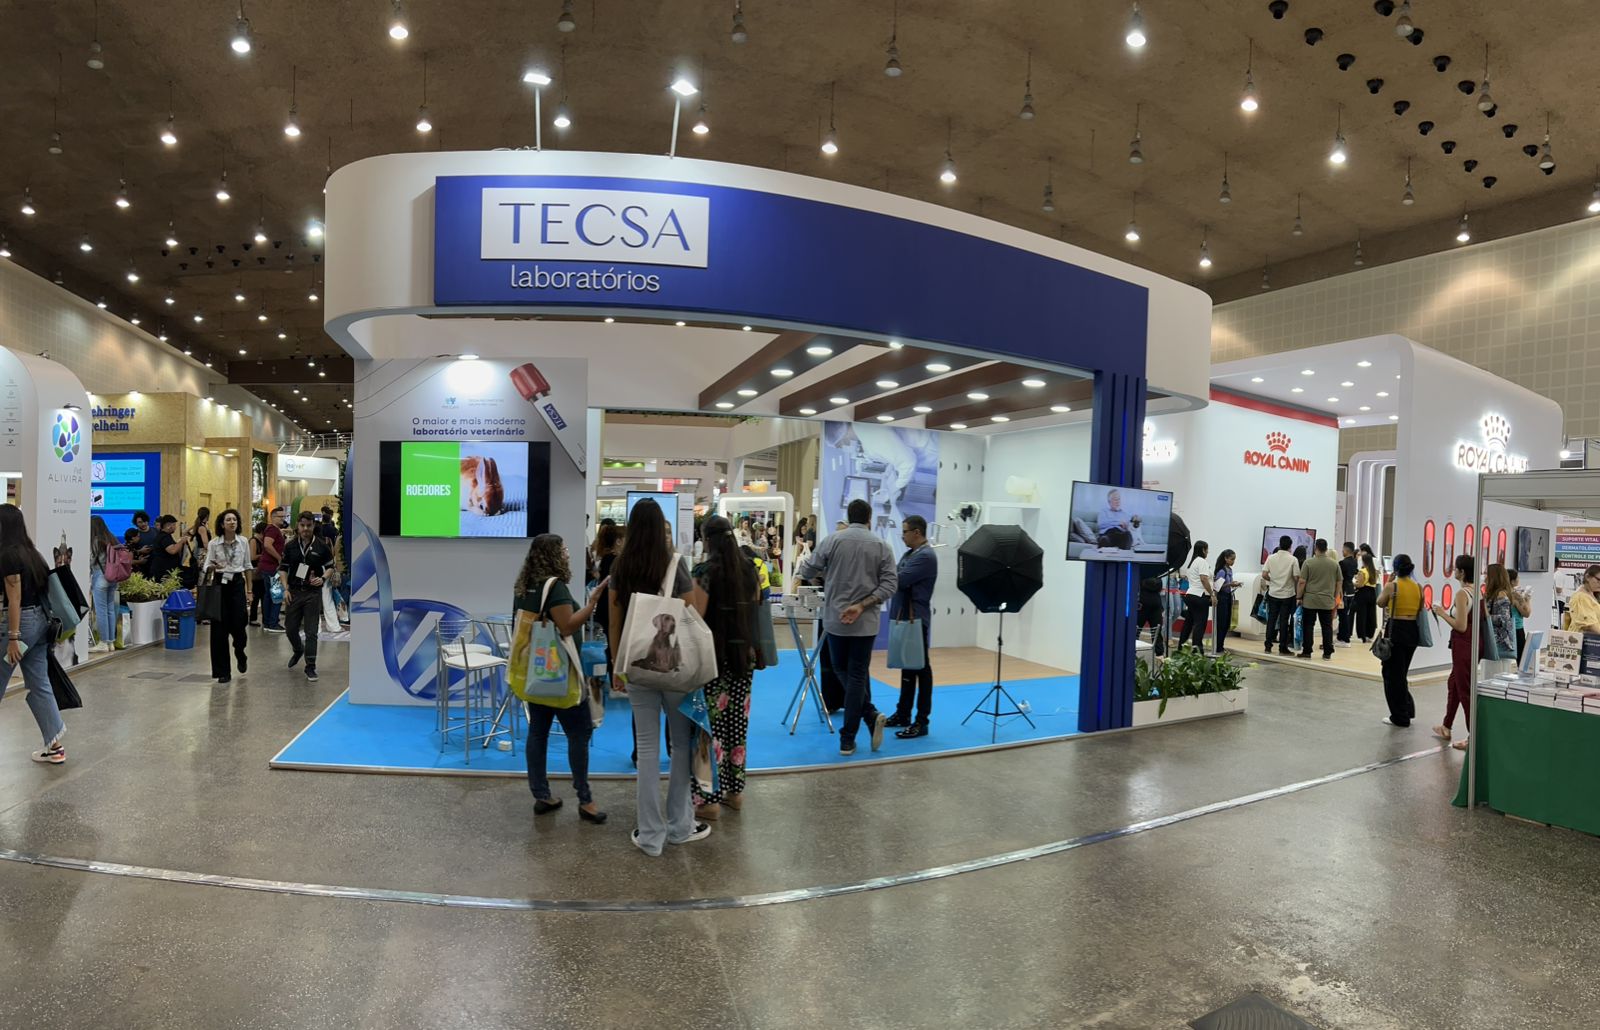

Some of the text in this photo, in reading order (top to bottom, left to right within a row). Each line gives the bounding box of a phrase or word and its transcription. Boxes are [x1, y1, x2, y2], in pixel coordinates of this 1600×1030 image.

[499, 203, 691, 251] TECSA
[510, 264, 660, 292] laboratórios
[412, 417, 420, 425] O
[422, 417, 449, 425] maior
[459, 417, 482, 425] mais
[484, 417, 526, 425] moderno
[412, 427, 525, 436] laboratório veterinário
[1244, 450, 1310, 473] ROYAL CANIN
[1458, 444, 1493, 474] ROYAL
[48, 473, 82, 484] ALIVIRA
[406, 484, 451, 496] ROEDORES
